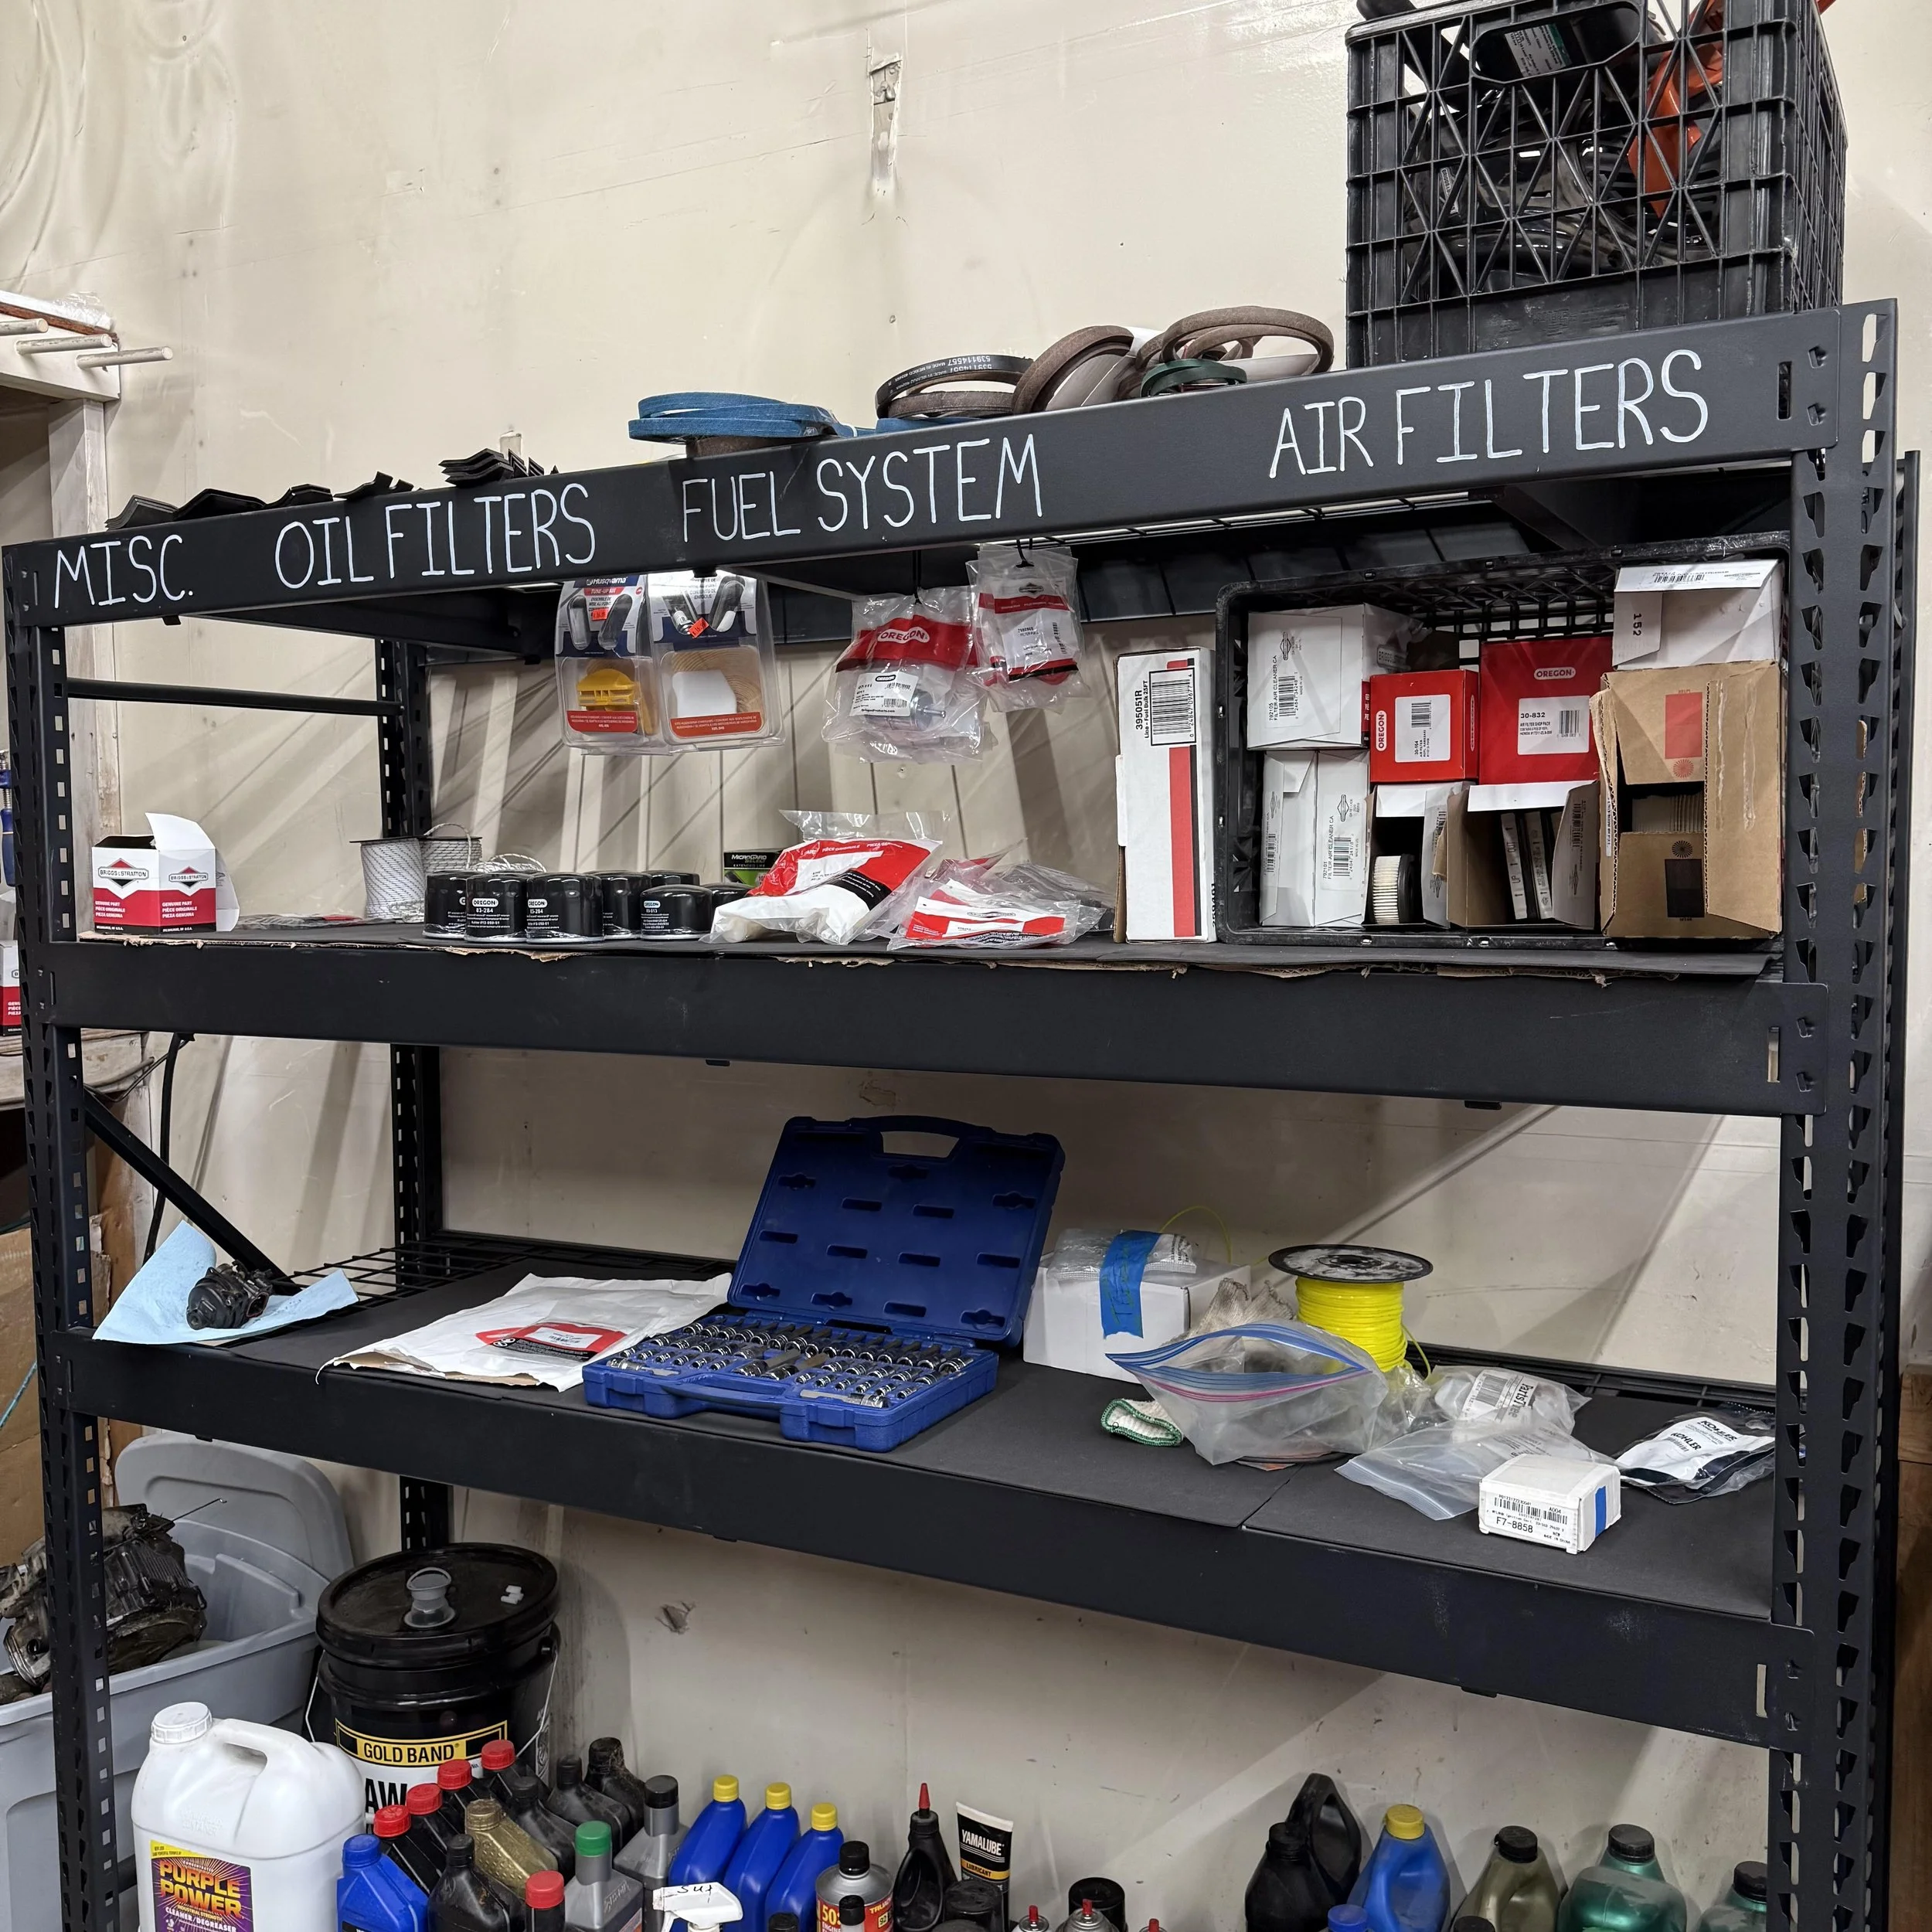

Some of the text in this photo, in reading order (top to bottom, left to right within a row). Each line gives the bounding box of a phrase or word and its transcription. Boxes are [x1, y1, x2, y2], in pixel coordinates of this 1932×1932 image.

[948, 355, 991, 366] 539114557
[1269, 349, 1708, 478] AIR FILTERS
[682, 434, 1043, 543] FUEL SYSTEM
[274, 483, 595, 588] OIL FILTERS
[55, 535, 193, 608] MISC.
[1633, 613, 1642, 636] 152
[881, 631, 925, 641] OREGON
[1272, 655, 1277, 664] CA
[1536, 668, 1573, 679] OREGON
[1134, 689, 1143, 730] 395051R
[1511, 875, 1521, 883] UP
[1509, 1383, 1534, 1418] PartsTree
[1671, 1433, 1702, 1451] KOHLER
[1496, 1516, 1533, 1533] F7-8858
[363, 1743, 454, 1763] GOLD BAND
[365, 1777, 408, 1814] AW
[961, 1828, 1002, 1856] YAMALUBE
[182, 1860, 215, 1872] CONCENTRATED
[966, 1862, 992, 1877] LUBRICANT
[159, 1860, 241, 1899] PURPLE
[160, 1878, 242, 1918] POWER
[177, 1904, 223, 1921] INDUSTRIAL STRENGTH
[822, 1904, 841, 1926] 50:
